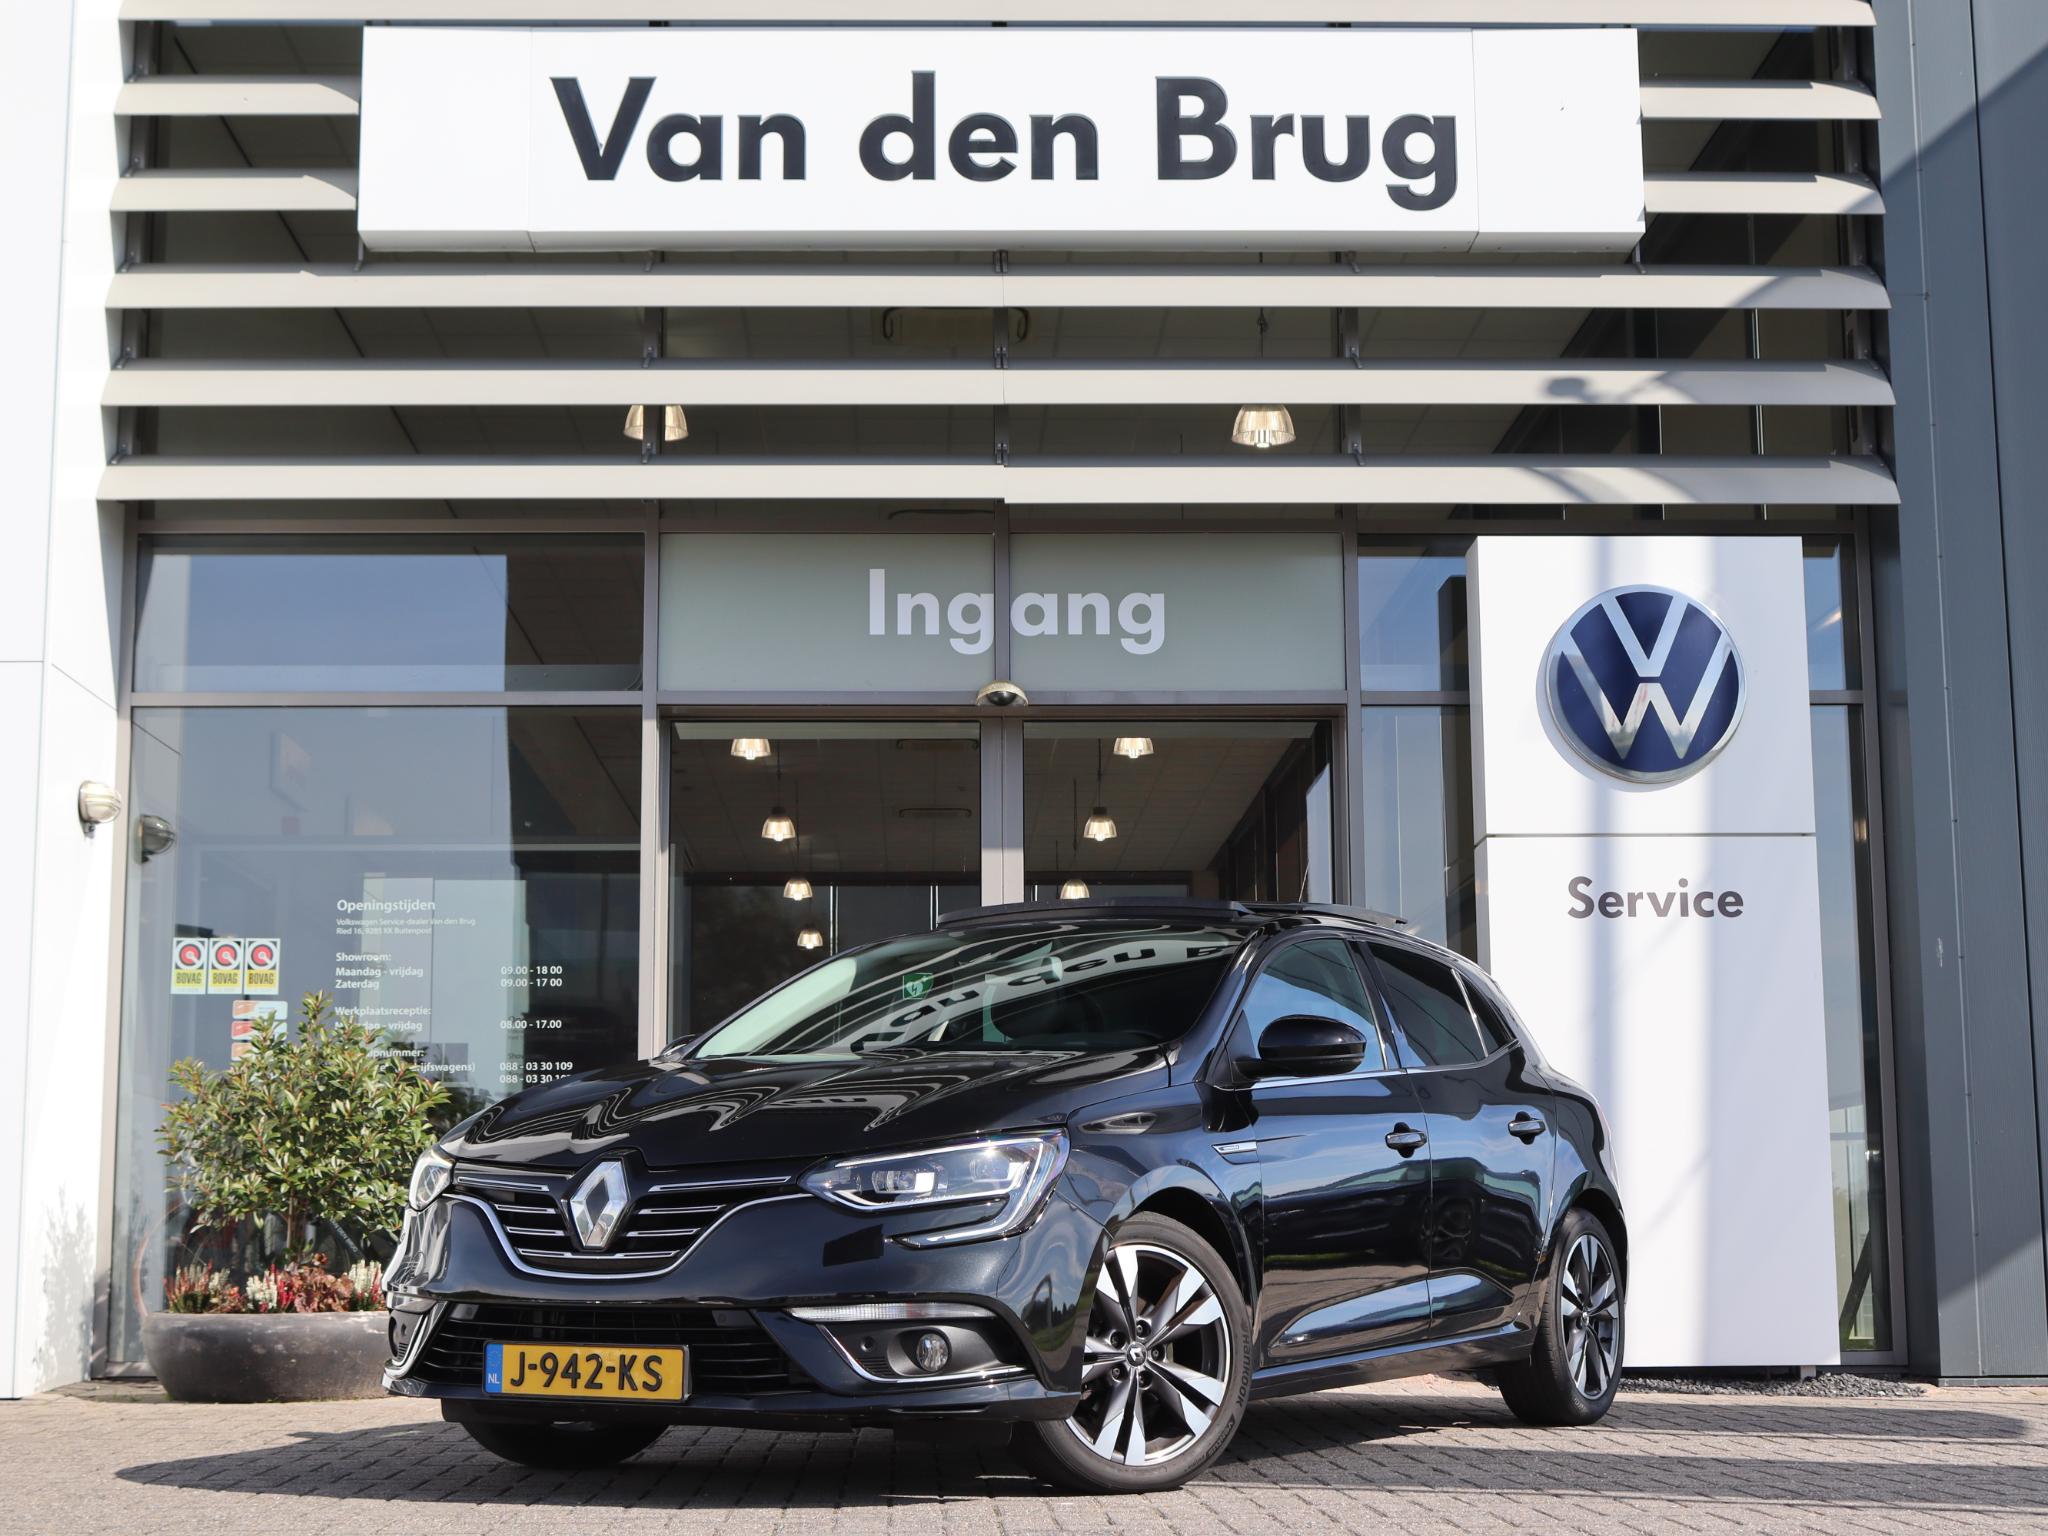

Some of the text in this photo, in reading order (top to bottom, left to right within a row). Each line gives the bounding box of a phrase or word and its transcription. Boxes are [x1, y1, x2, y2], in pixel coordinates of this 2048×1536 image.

[549, 70, 1458, 212] Van den Brug
[869, 568, 1166, 655] Ingang
[1567, 876, 1744, 919] Service
[336, 899, 436, 913] Openingstijden
[335, 952, 392, 962] Showroom:
[335, 966, 382, 978] Maandag
[389, 966, 424, 978] vrijdag
[500, 965, 528, 975] 09.00
[248, 972, 274, 985] BOVAG
[335, 978, 380, 990] Zaterdag
[500, 978, 528, 987] 09.00
[334, 1006, 432, 1017] Werkplaatsreceptie:
[388, 1020, 423, 1032] vrijdag
[499, 1020, 527, 1029] 08.00
[536, 1020, 562, 1029] 17.00
[499, 1062, 518, 1071] 088
[526, 1062, 538, 1071] 03
[540, 1062, 553, 1071] 30
[555, 1062, 573, 1071] 109
[499, 1075, 518, 1084] 088
[526, 1075, 538, 1084] 03
[510, 1351, 664, 1392] J-942-KS
[488, 1373, 500, 1384] NL
